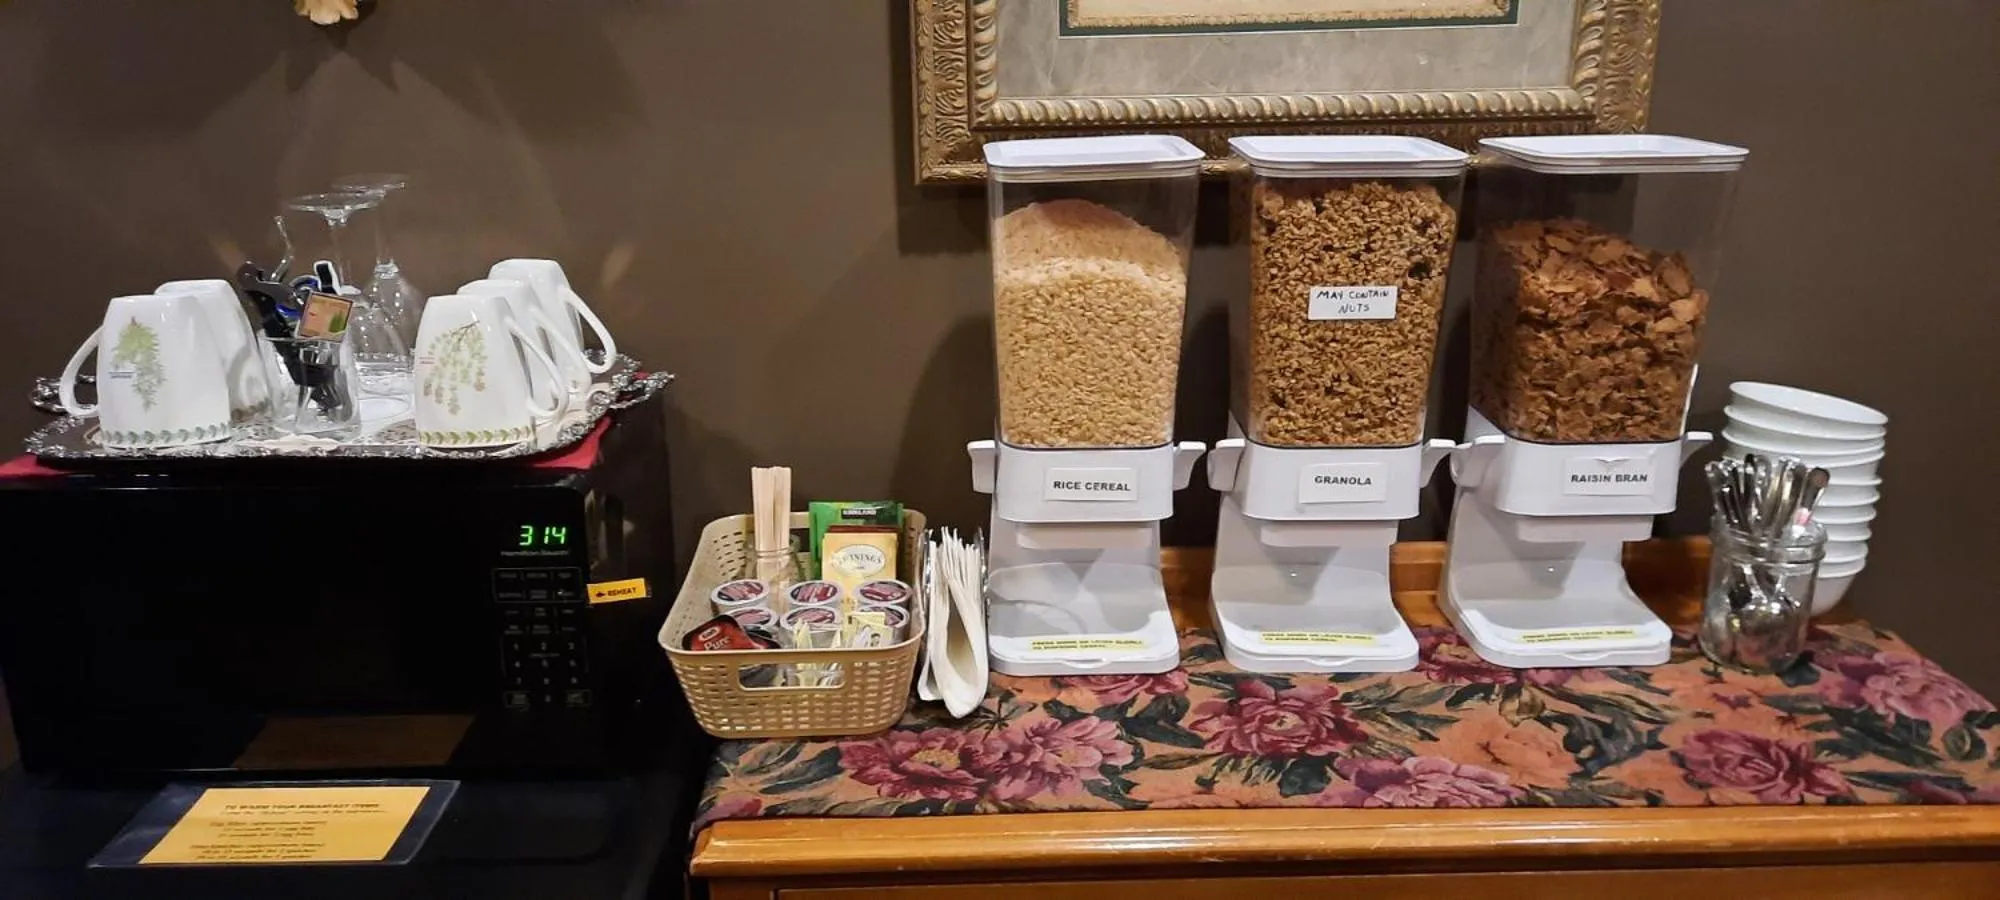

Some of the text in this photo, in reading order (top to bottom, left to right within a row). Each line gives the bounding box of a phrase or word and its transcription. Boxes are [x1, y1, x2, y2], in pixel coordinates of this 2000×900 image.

[1317, 289, 1389, 300] MAY CONTAIN
[1338, 303, 1370, 314] NUTS
[1314, 475, 1372, 485] GRANOLA
[1571, 474, 1648, 482] RAISIN BRAN
[1053, 480, 1131, 491] RICE CEREAL
[607, 586, 637, 597] REHEAT
